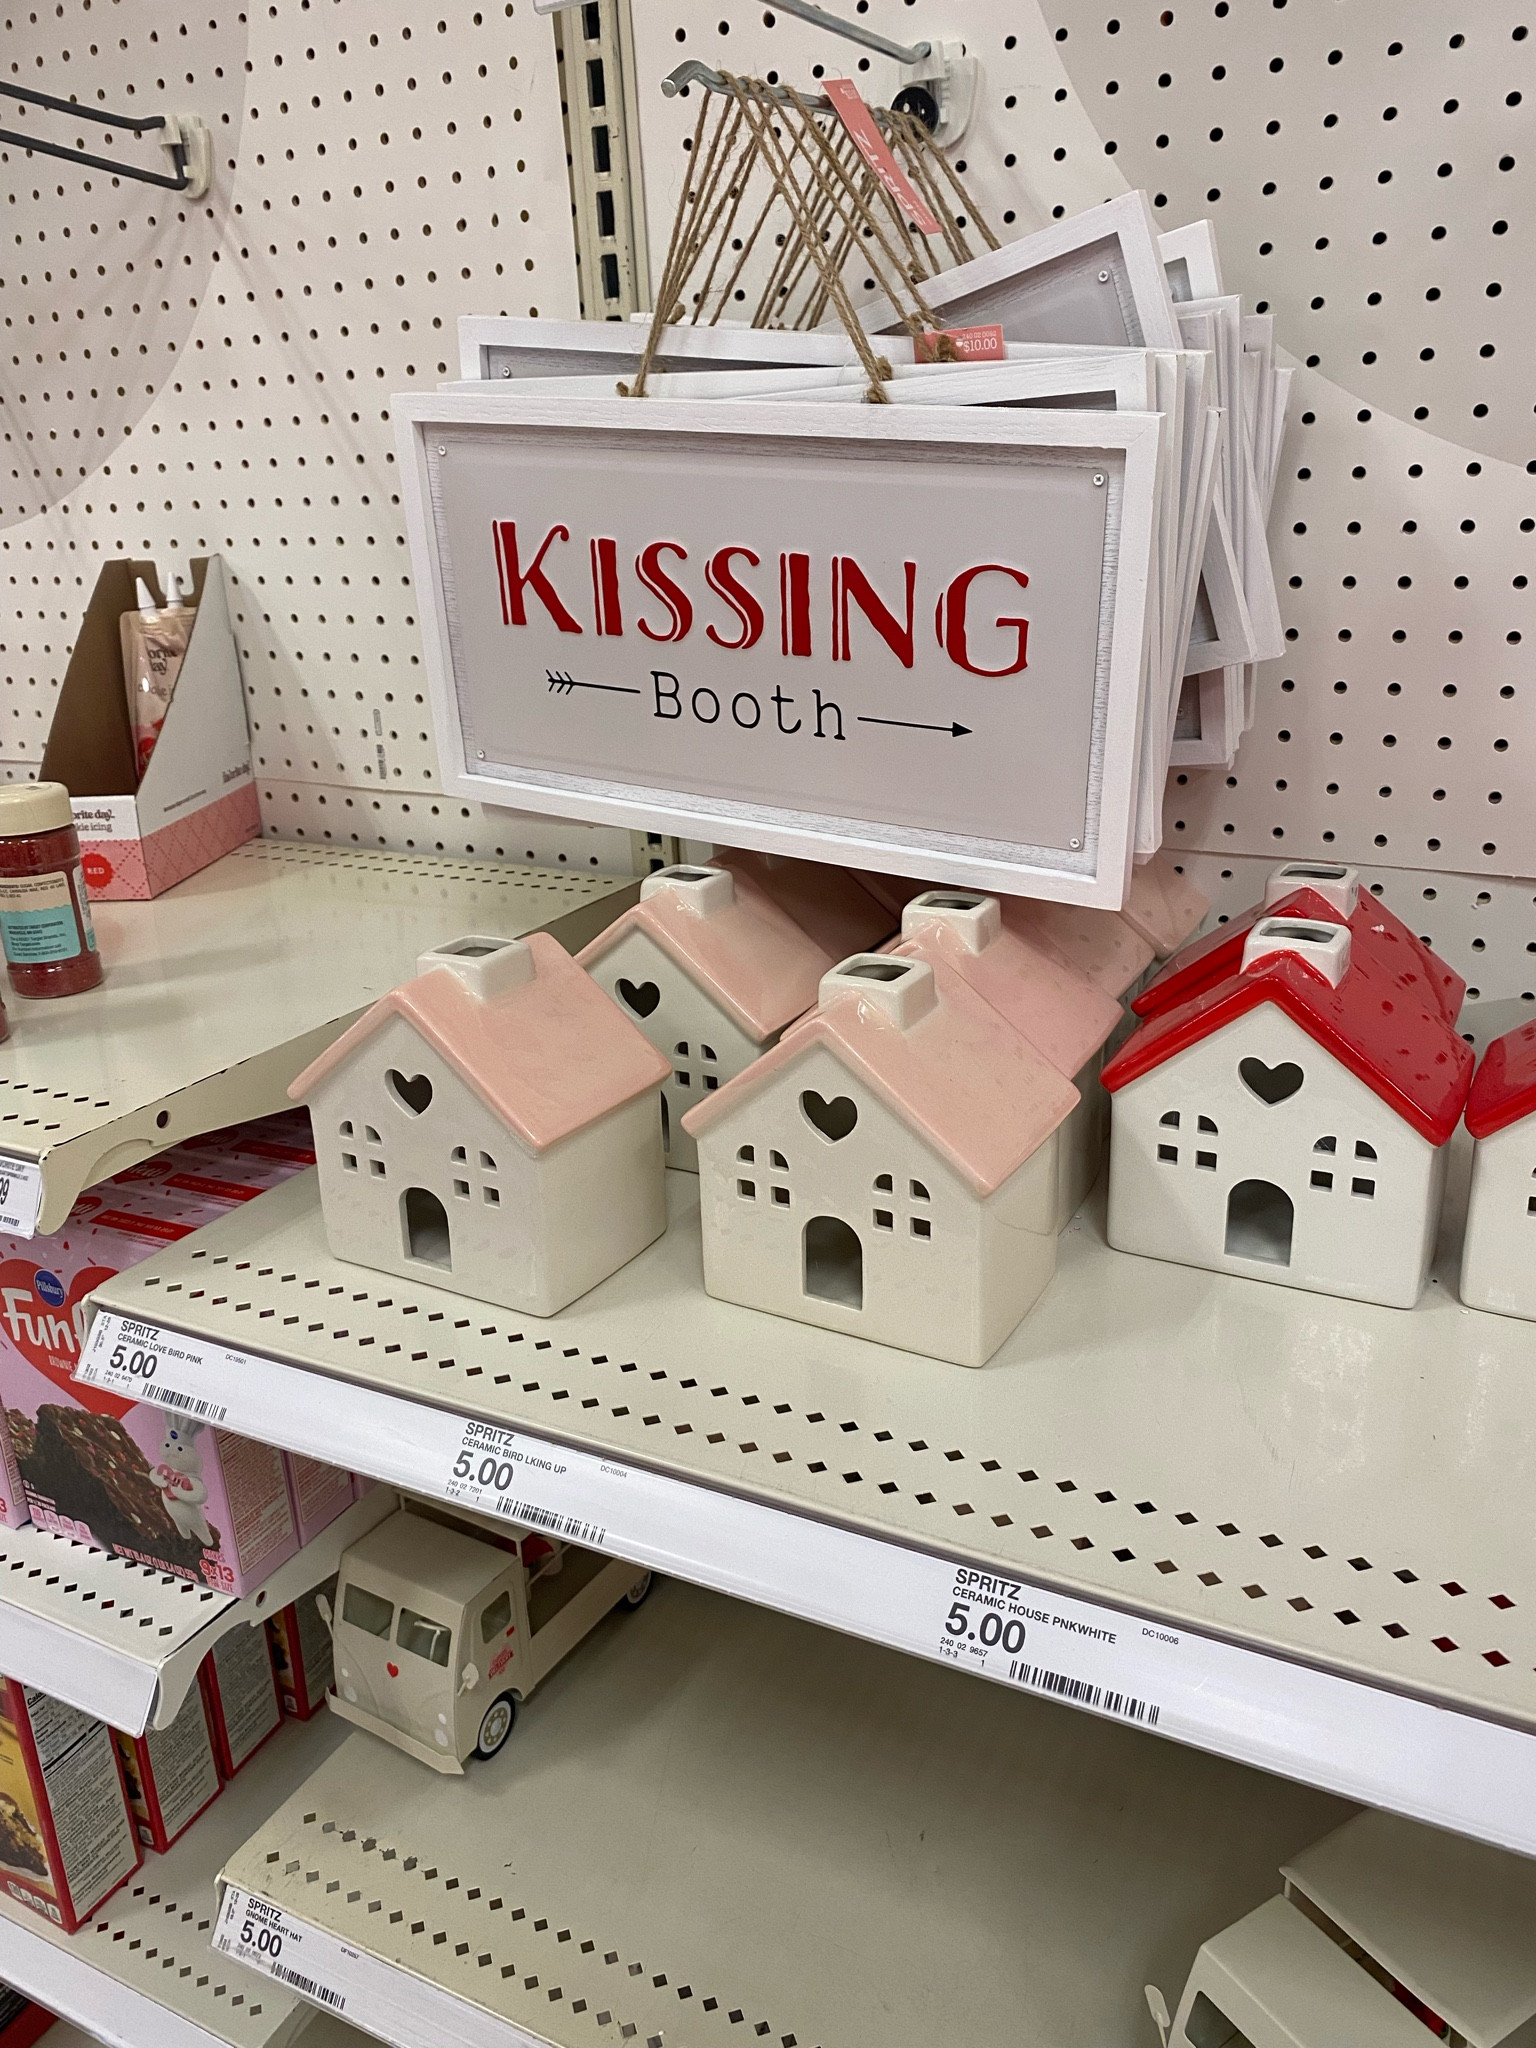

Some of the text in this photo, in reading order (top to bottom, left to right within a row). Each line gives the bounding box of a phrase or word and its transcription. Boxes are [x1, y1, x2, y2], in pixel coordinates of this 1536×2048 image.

[963, 337, 998, 353] $10.00
[492, 520, 1031, 678] KISSING
[650, 670, 847, 741] Booth
[86, 867, 105, 875] RED
[36, 1280, 64, 1299] Pillsbury
[120, 1320, 160, 1341] SPRITZ
[109, 1344, 158, 1379] 5.00
[117, 1333, 149, 1349] CERAMIC
[149, 1342, 168, 1355] LOVE
[168, 1348, 186, 1360] BIRD
[185, 1353, 204, 1365] PINK
[465, 1422, 515, 1447] SPRITZ
[461, 1437, 567, 1475] CERAMIC BIRD LKING UP
[452, 1450, 514, 1491] 5.00
[600, 1465, 628, 1478] DC10004
[447, 1478, 459, 1487] 240
[459, 1482, 468, 1491] 02
[199, 1559, 235, 1582] 9x13
[220, 1581, 235, 1593] SIZE
[955, 1568, 1022, 1601] SPRITZ
[945, 1601, 1026, 1654] 5.00
[952, 1586, 1117, 1644] CERAMIC HOUSE PNKWHITE
[940, 1636, 988, 1657] 240 02 9657
[1141, 1627, 1180, 1645] DC10006
[938, 1646, 986, 1667] 1-3-3 1
[247, 1898, 283, 1923] SPRITZ
[240, 1919, 283, 1958] 5.00
[245, 1909, 268, 1926] GNOME
[268, 1919, 290, 1935] HEART
[289, 1931, 303, 1943] HAT
